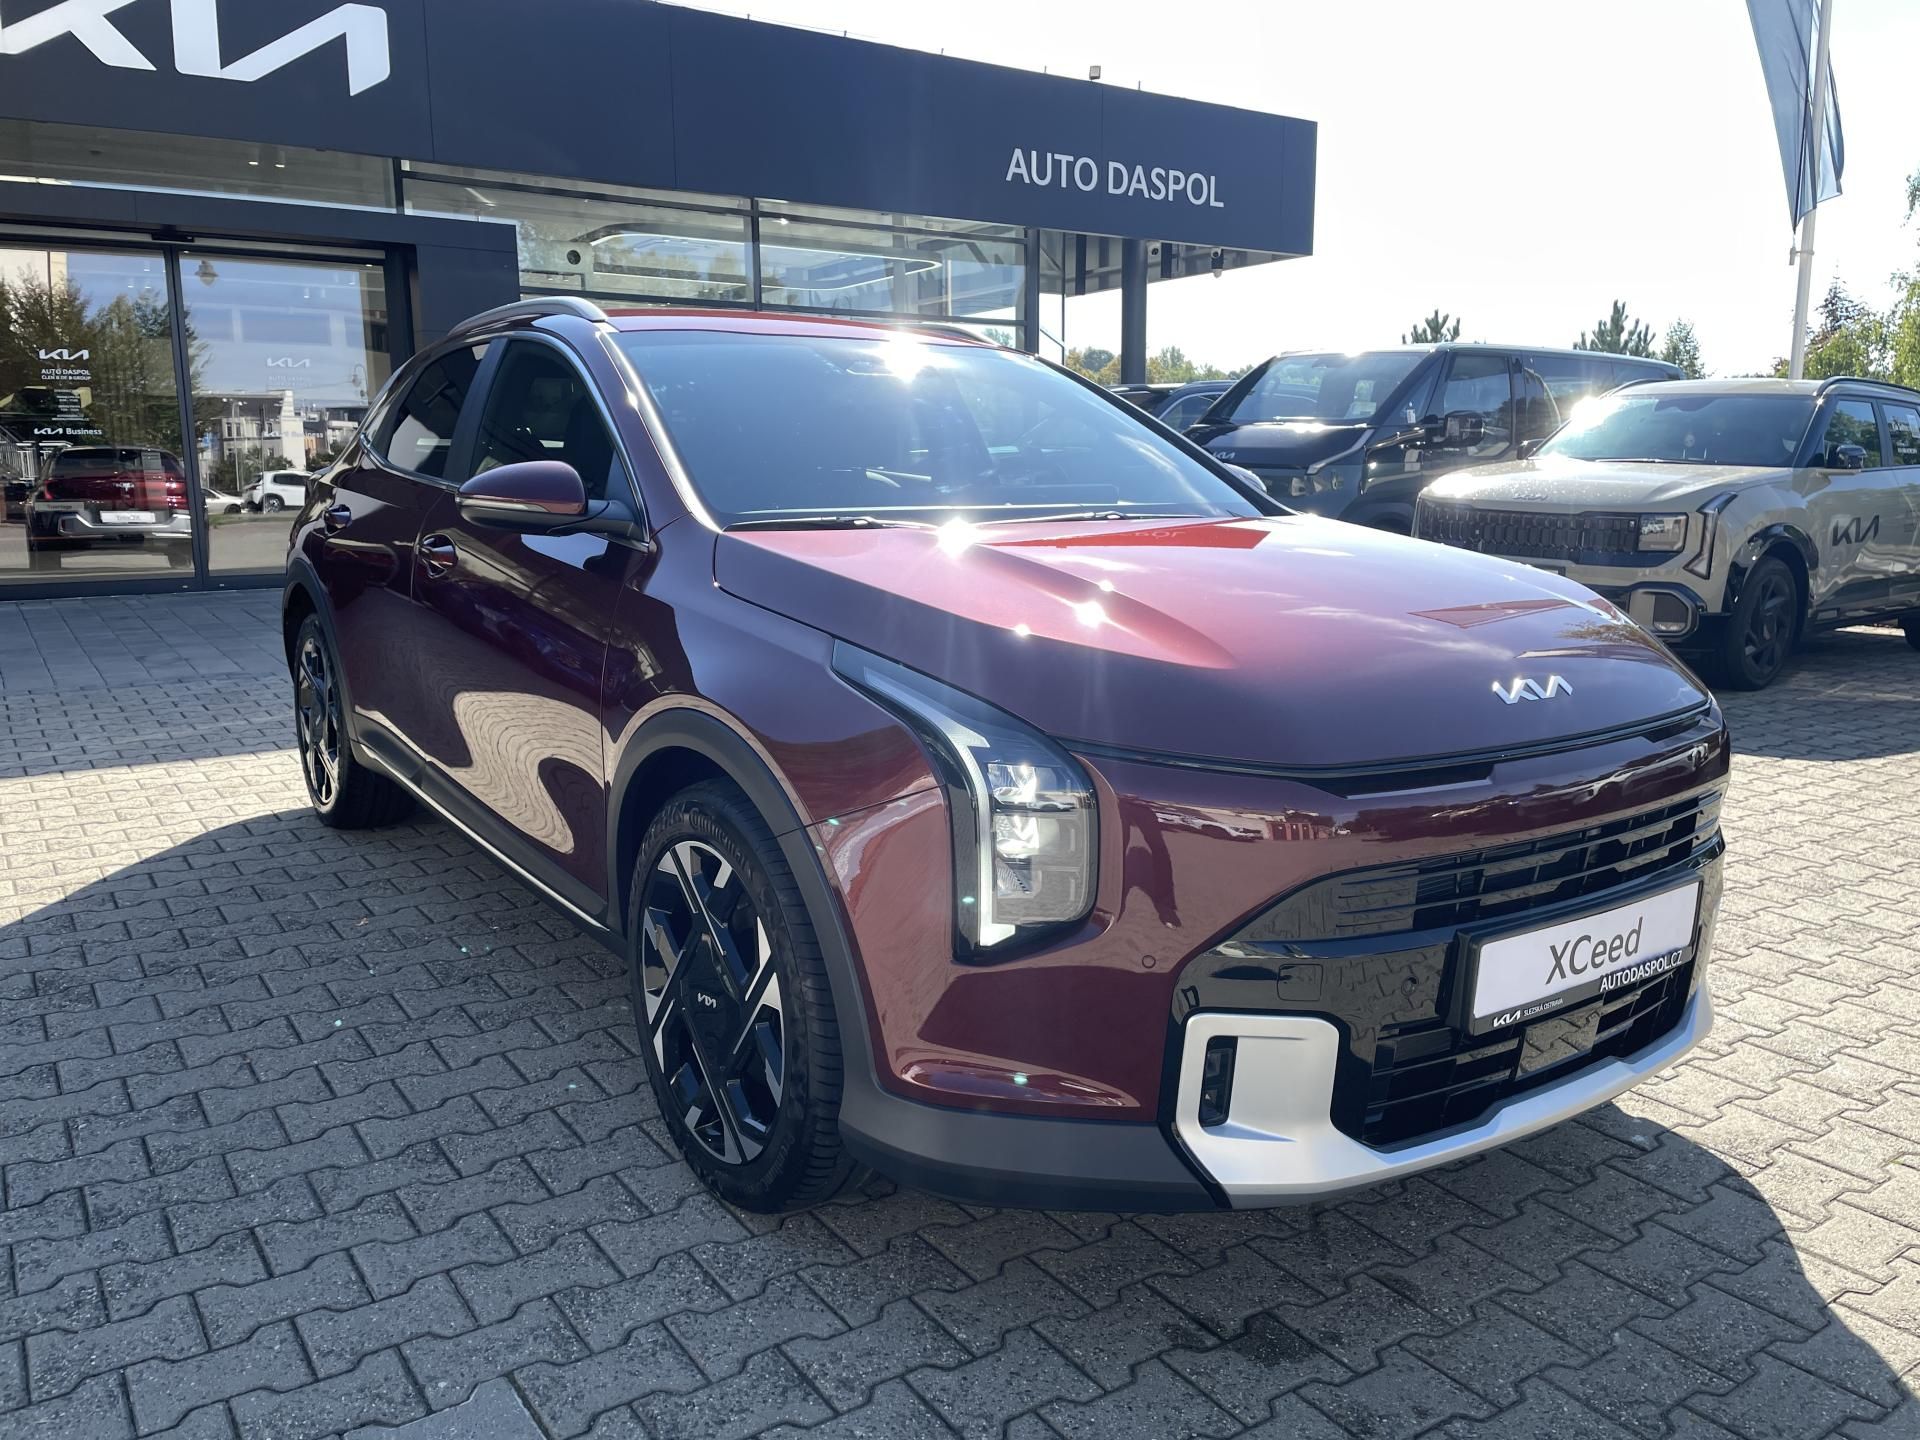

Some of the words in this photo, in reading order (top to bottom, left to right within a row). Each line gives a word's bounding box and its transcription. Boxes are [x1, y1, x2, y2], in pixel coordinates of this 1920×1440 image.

[1005, 147, 1098, 192] AUTO
[1108, 160, 1225, 208] DASPOL
[39, 348, 90, 360] KIA
[266, 357, 311, 368] KIA
[62, 368, 91, 376] DASPOL
[33, 427, 64, 435] KIA
[65, 427, 103, 435] Business
[1831, 514, 1880, 547] KIA
[1492, 675, 1574, 705] KIA
[1546, 916, 1643, 985] XCeed
[1600, 950, 1683, 993] AUTODASPOL.CZ
[1493, 1009, 1521, 1028] KIA
